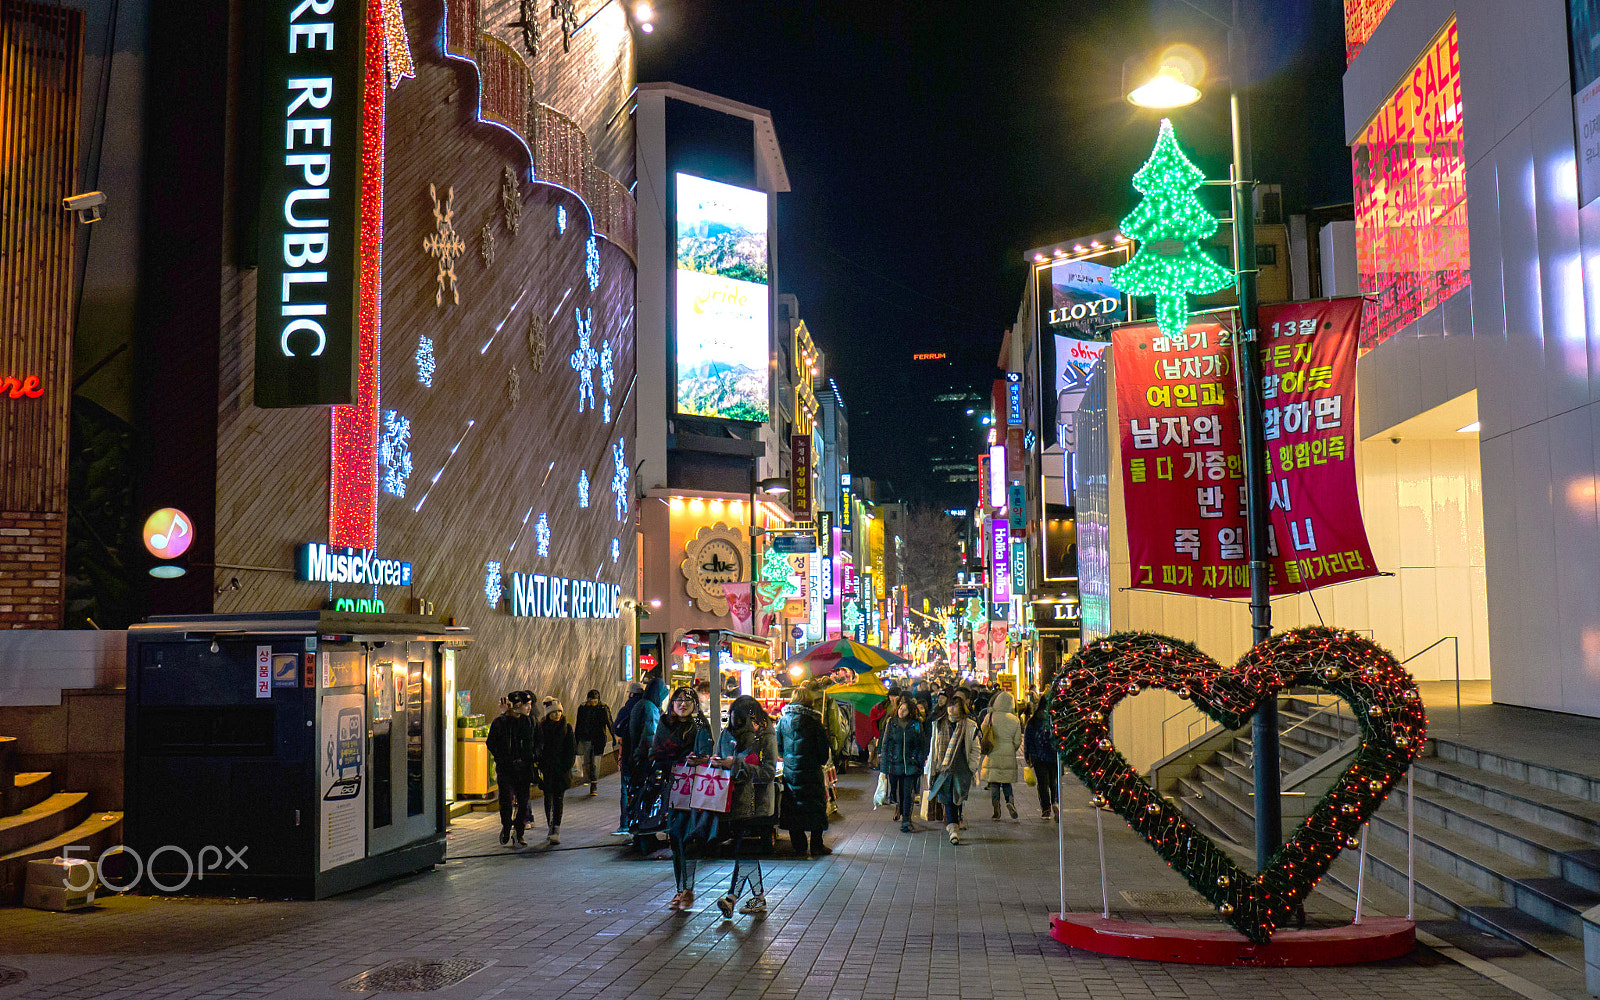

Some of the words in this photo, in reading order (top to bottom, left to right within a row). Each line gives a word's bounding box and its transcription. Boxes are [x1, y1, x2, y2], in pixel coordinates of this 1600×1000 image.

[1413, 21, 1460, 117] SALE
[1367, 87, 1406, 168] SALE
[1424, 78, 1463, 154] SALE
[1382, 127, 1416, 195] SALE
[1431, 126, 1465, 189] SALE
[1395, 165, 1425, 223] SALE
[1440, 168, 1467, 216] SALE
[280, 76, 333, 358] REPUBLIC
[1410, 196, 1436, 240] SALE
[1048, 296, 1119, 325] LLOYD
[913, 352, 947, 361] FERRUM
[1151, 331, 1209, 353] 레위기
[1271, 318, 1318, 338] 13절
[1153, 354, 1230, 380] (남자가)
[1259, 342, 1314, 371] 구든지
[1146, 382, 1225, 408] 여인과
[1261, 364, 1333, 400] 합하듯
[1130, 413, 1223, 450] 남자와
[1261, 394, 1344, 442] 합하면
[1129, 457, 1148, 484] 둘
[1156, 455, 1174, 482] 다
[1278, 435, 1346, 473] 행함인즉
[796, 465, 807, 509] 성형외과
[308, 542, 401, 586] MusicKorea
[994, 527, 1007, 560] Holika
[995, 562, 1007, 596] Holika
[1016, 551, 1024, 587] LLOYD
[1139, 564, 1154, 586] 그
[1162, 563, 1195, 588] 피가
[1284, 549, 1366, 584] 돌아가리라
[513, 571, 569, 617] NATURE
[571, 578, 621, 619] REPUBLIC
[258, 649, 270, 693] 상품권
